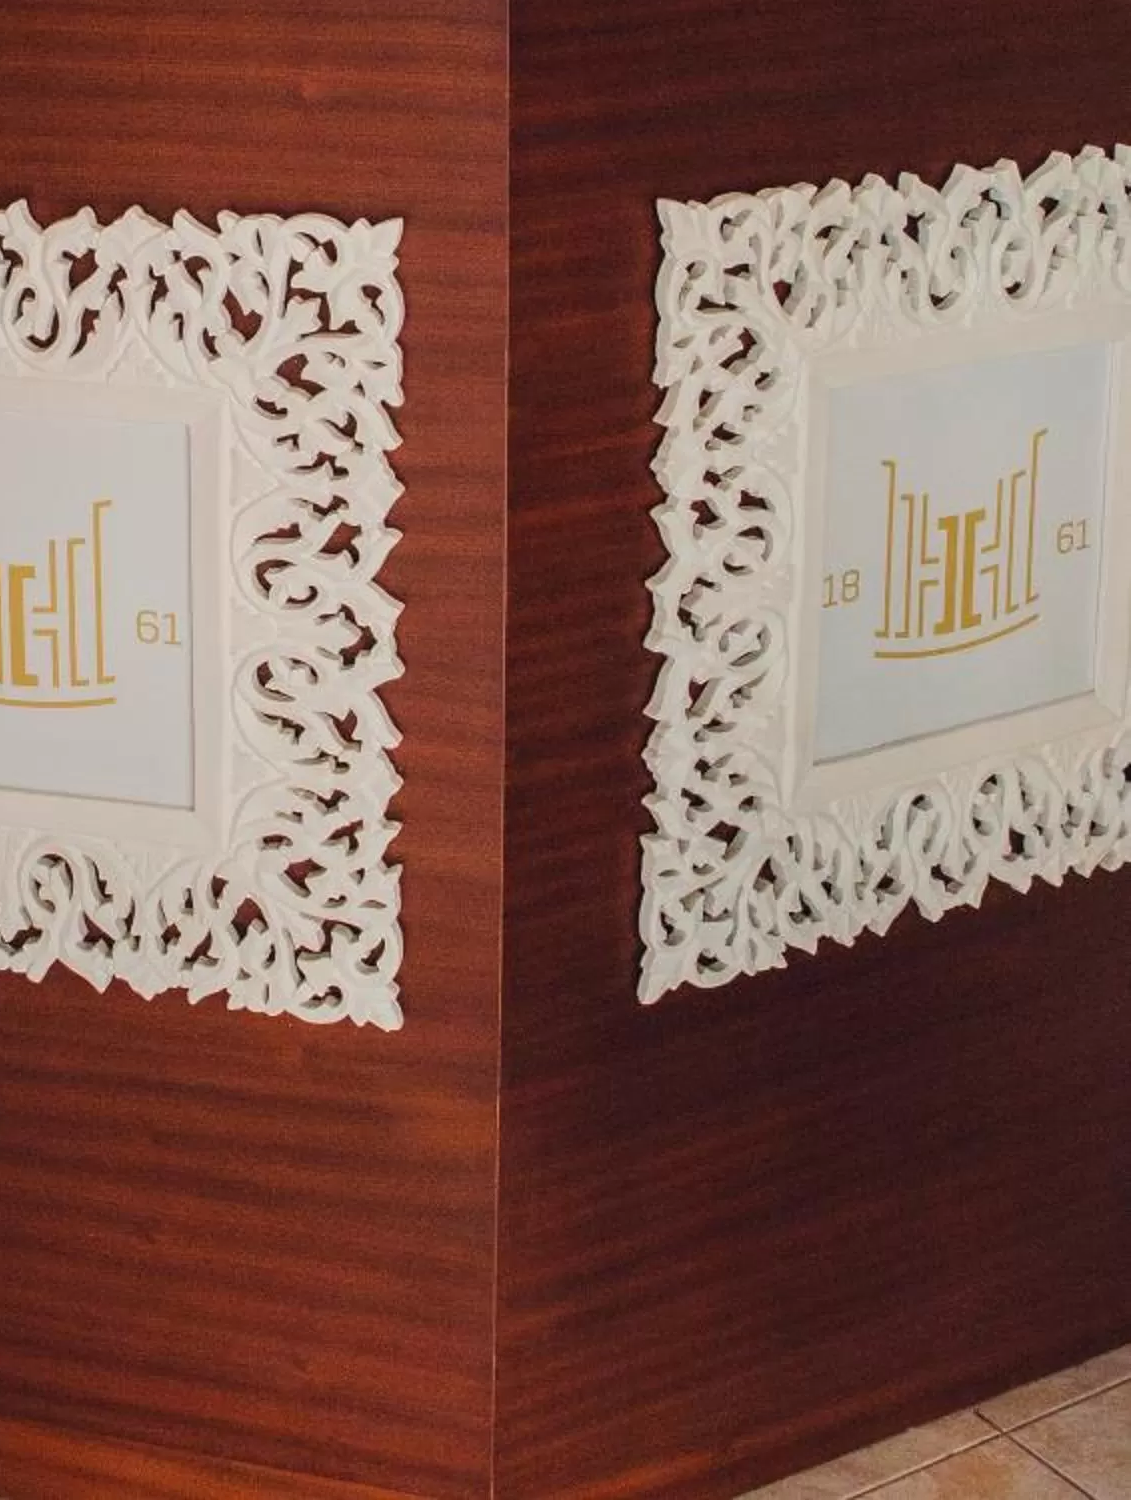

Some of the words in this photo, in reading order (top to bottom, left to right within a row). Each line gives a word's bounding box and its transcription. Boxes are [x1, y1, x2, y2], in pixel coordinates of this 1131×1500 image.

[821, 569, 861, 609] 18
[1056, 518, 1091, 554] 61
[135, 609, 182, 646] 61
